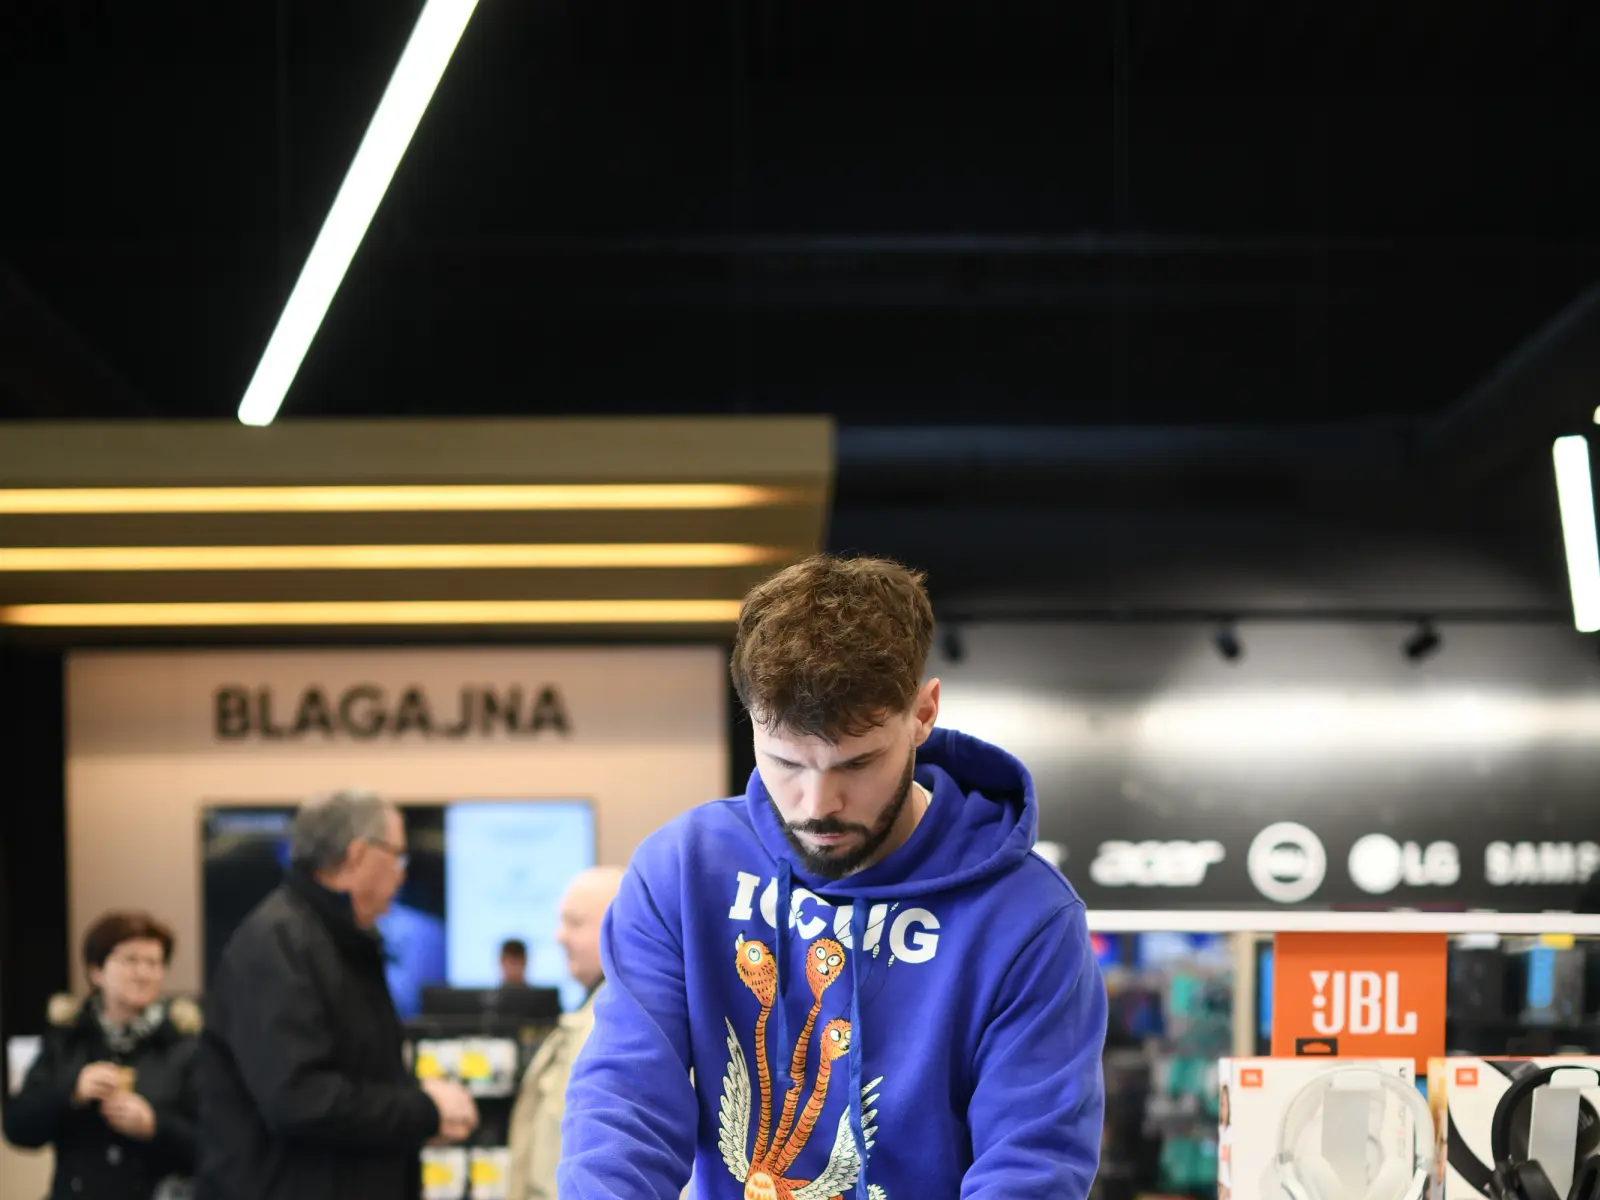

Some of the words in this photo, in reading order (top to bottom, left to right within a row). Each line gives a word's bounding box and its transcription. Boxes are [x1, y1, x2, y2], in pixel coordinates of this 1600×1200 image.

[213, 684, 571, 740] BLAGAJNA
[1403, 840, 1461, 886] LG
[1310, 970, 1418, 1035] JBL
